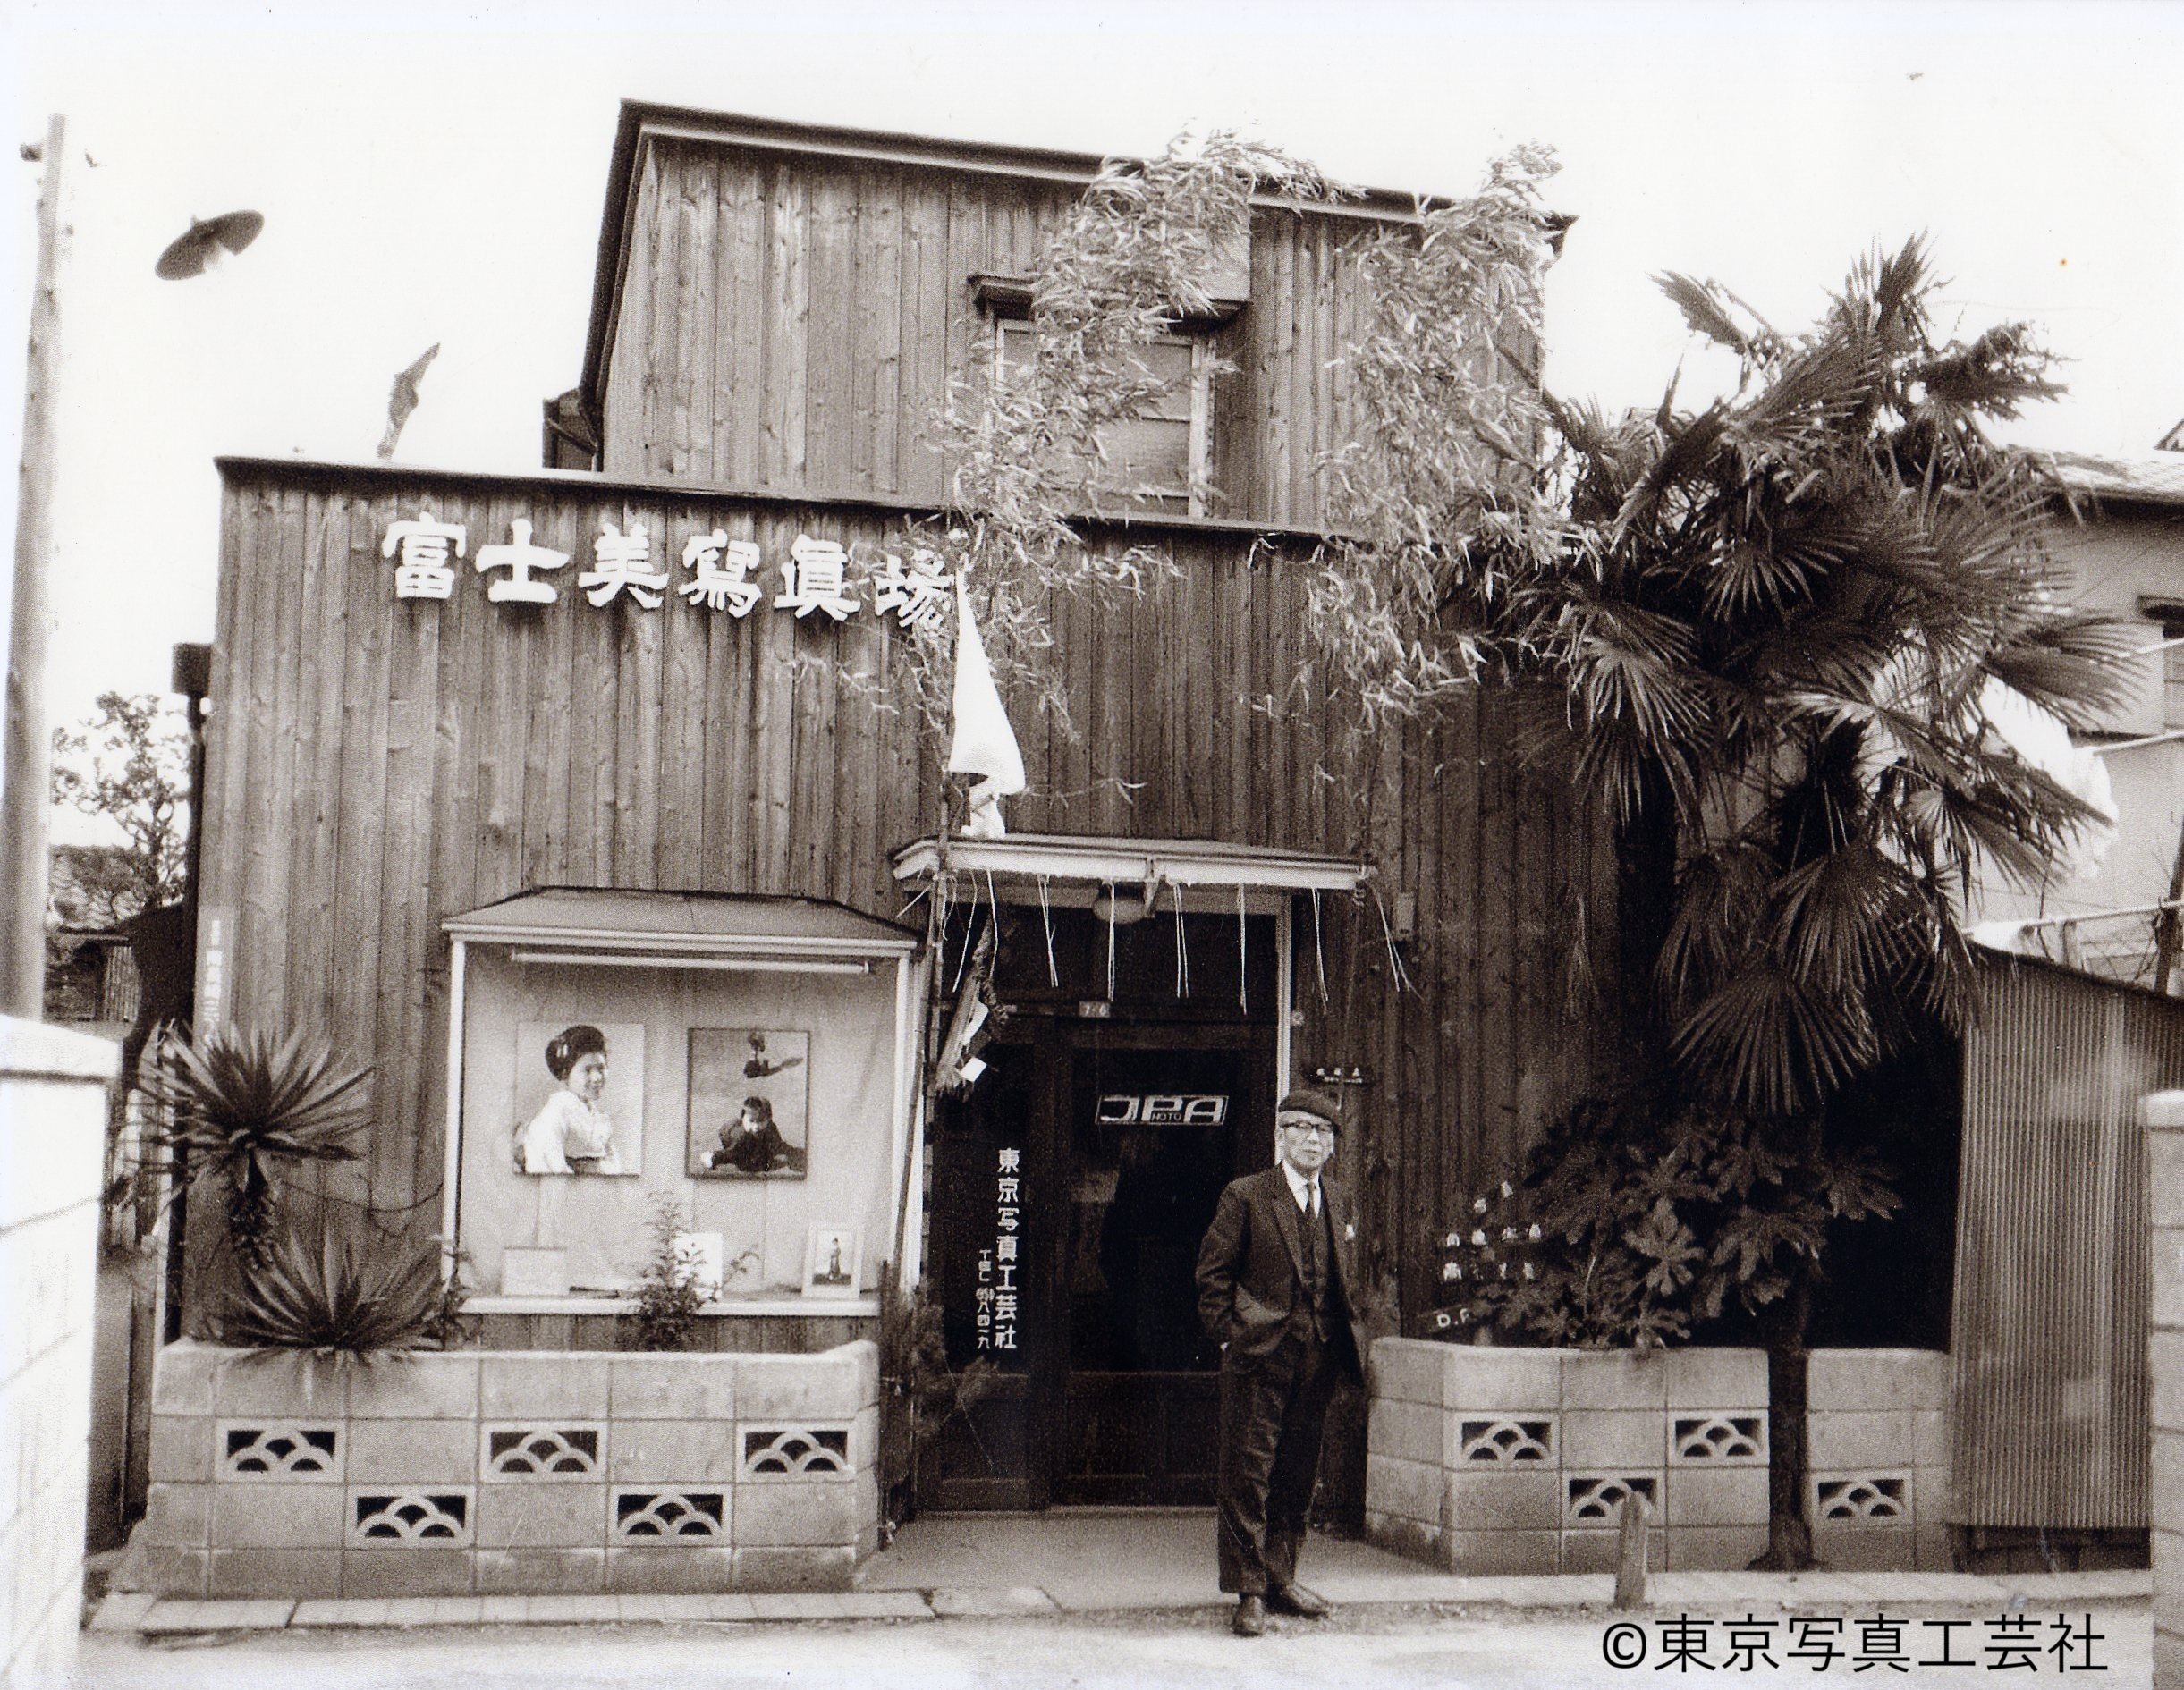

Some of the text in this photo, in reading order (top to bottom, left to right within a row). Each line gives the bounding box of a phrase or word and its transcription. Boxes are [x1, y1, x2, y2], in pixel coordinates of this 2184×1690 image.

[995, 1147, 1020, 1349] 東京写真工芸社
